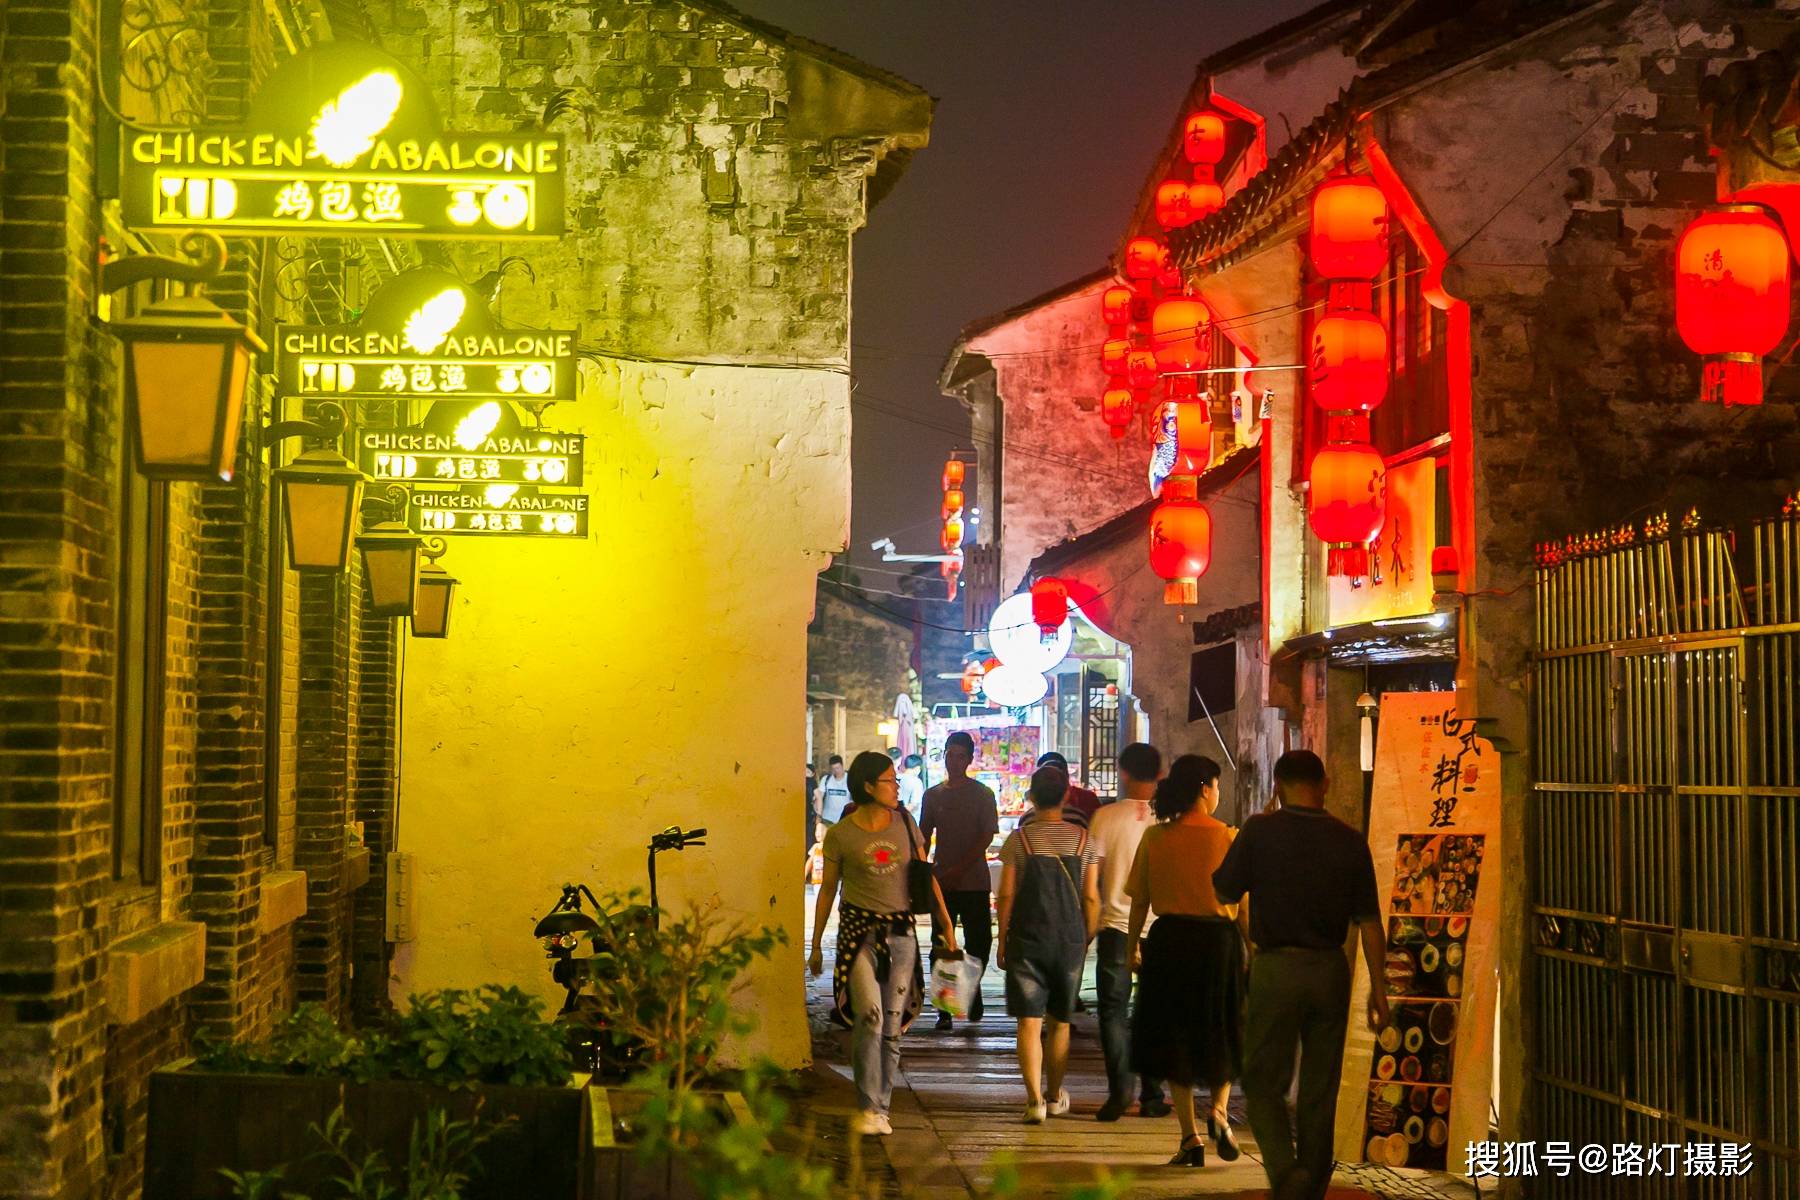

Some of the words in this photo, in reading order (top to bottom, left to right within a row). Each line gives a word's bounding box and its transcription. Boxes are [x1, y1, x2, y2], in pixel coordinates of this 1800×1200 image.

[133, 132, 302, 167] CHICKEN
[370, 141, 558, 174] ABALONE
[273, 181, 404, 222] 鸡包渔
[285, 333, 399, 355] CHICKEN
[444, 336, 572, 357] ABALONE
[379, 364, 468, 393] 鸡包渔
[364, 434, 451, 450] CHICKEN
[484, 439, 581, 455] ABALONE
[435, 458, 502, 479] 鸡包渔
[412, 495, 483, 508] CHICKEN
[509, 498, 587, 511] ABALONE
